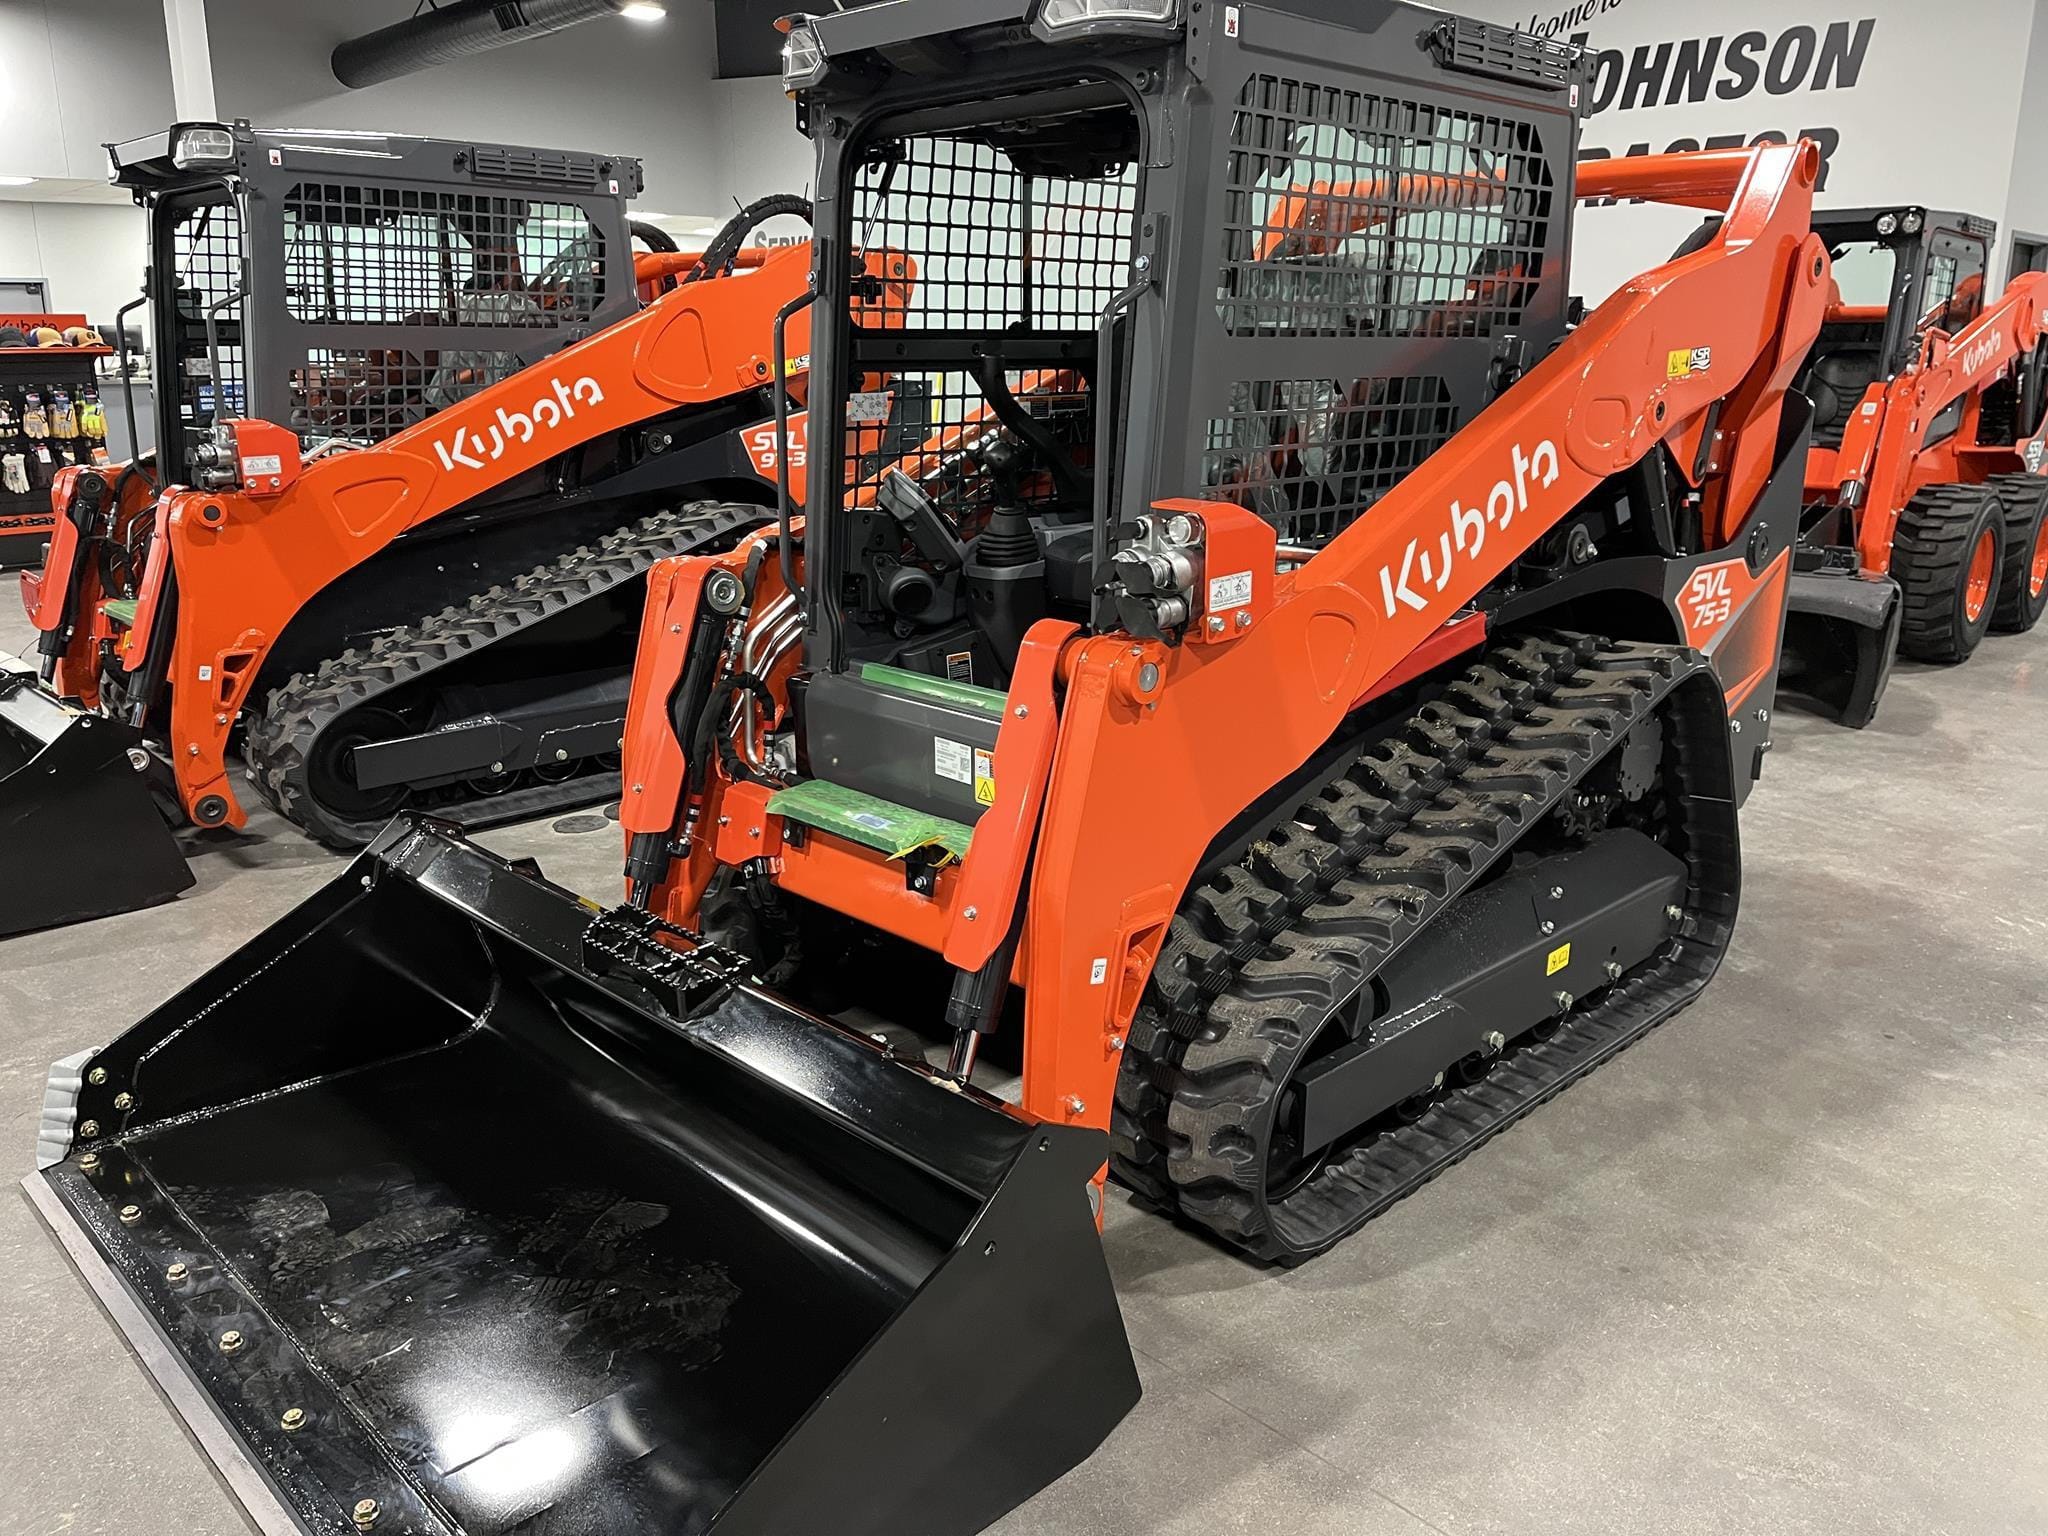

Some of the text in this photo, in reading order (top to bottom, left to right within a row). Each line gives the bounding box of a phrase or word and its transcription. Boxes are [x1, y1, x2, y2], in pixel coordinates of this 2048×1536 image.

[1570, 18, 1876, 114] OHNSON
[795, 355, 810, 368] KS
[1691, 347, 1711, 361] KSR
[1963, 328, 2001, 376] Kubota
[433, 377, 605, 471] Kubota
[1379, 439, 1559, 619] Kubota
[1688, 568, 1732, 605] SVL
[1692, 598, 1732, 628] 75-3
